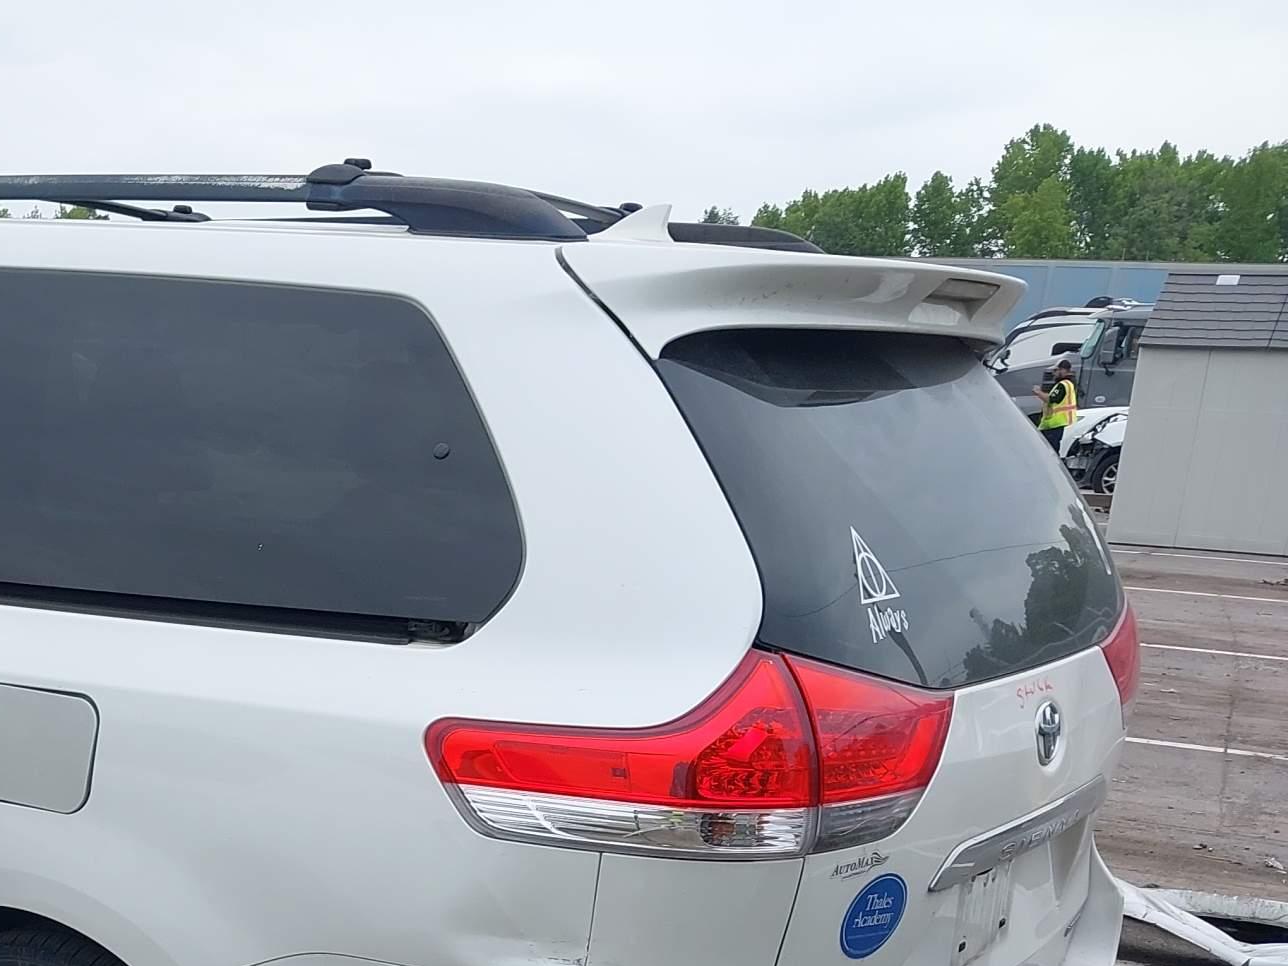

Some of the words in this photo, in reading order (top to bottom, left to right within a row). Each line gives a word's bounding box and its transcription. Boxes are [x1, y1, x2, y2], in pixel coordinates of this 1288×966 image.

[867, 603, 909, 643] Always
[865, 892, 894, 911] Thales
[852, 910, 894, 929] Academy
